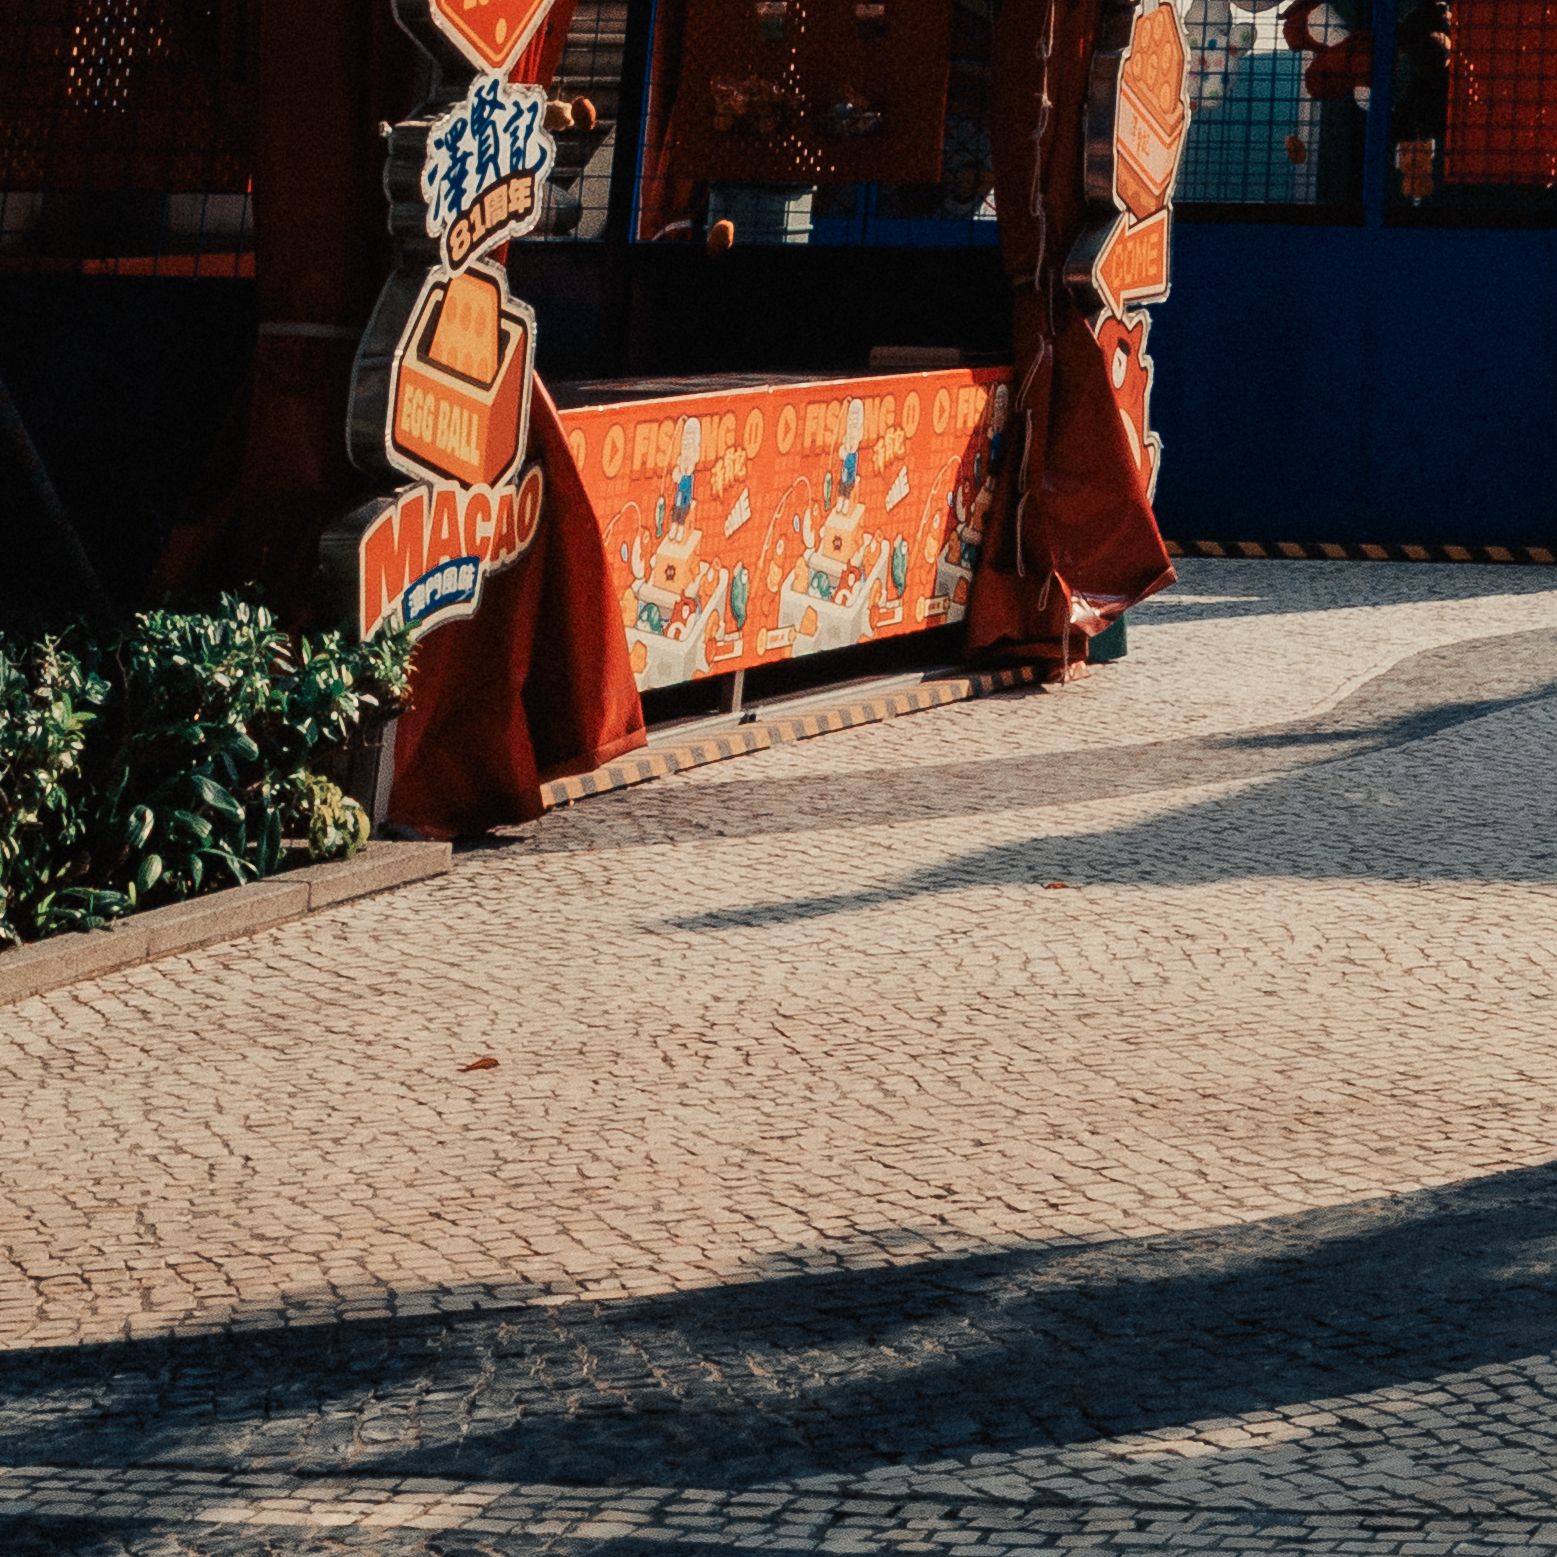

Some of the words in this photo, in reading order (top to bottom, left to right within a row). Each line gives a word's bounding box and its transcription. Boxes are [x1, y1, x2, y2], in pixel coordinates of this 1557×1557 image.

[449, 176, 533, 262] 81周年
[1111, 232, 1160, 288] COME
[402, 383, 436, 444] EGG
[435, 398, 481, 467] BALL
[364, 473, 543, 635] MACAO
